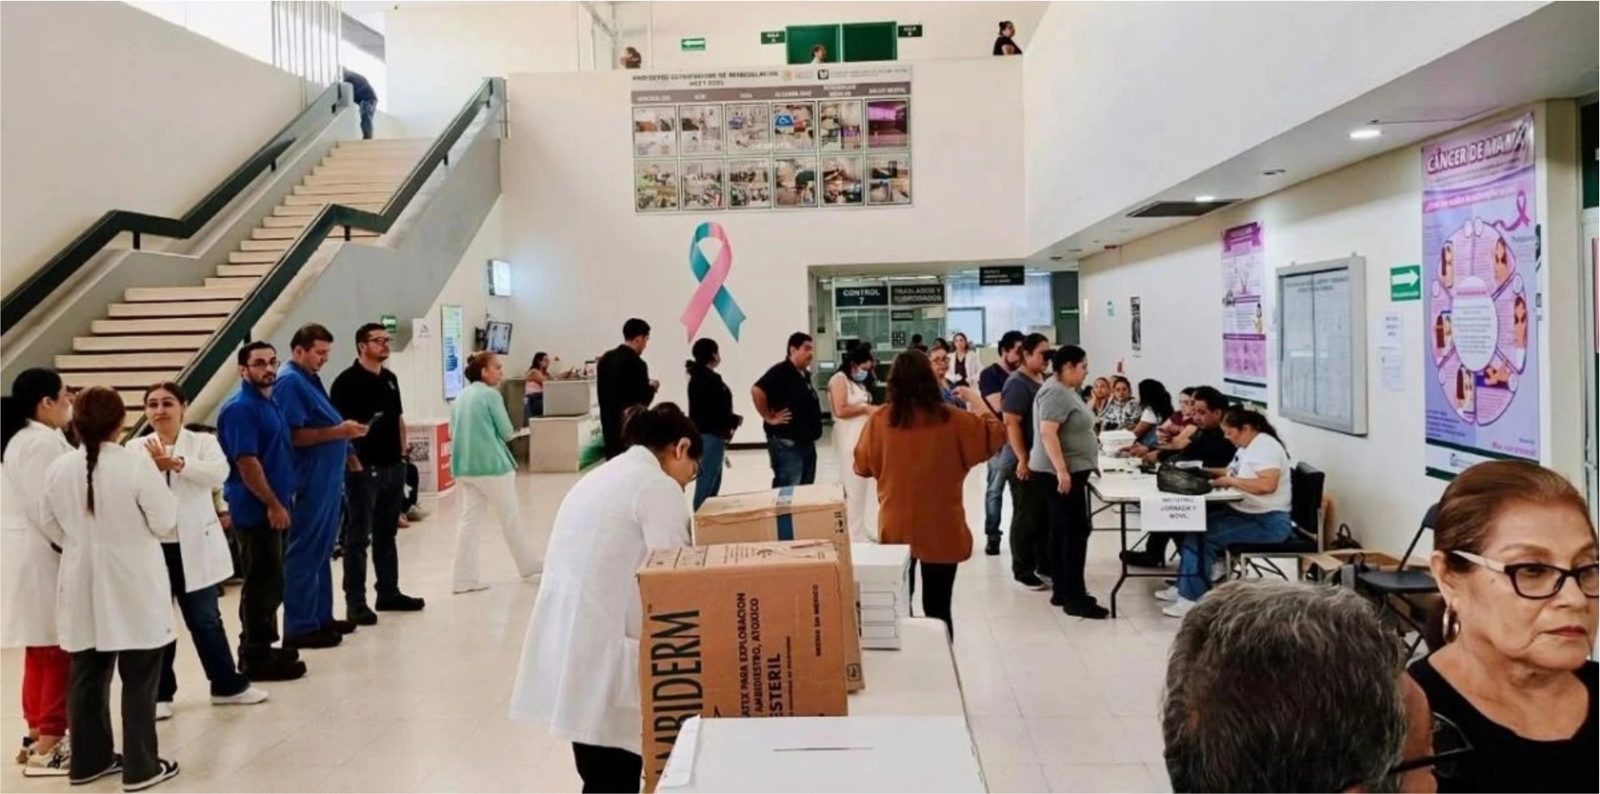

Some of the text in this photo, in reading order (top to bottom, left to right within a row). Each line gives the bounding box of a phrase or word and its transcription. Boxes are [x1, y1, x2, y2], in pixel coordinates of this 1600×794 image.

[1427, 146, 1467, 174] CÁNCER
[1469, 141, 1485, 163] DE
[842, 288, 881, 297] CONTROL
[894, 286, 942, 295] TRASLADOS Y
[858, 297, 865, 305] 7
[894, 294, 942, 302] SUBROGADOS
[750, 598, 760, 642] ATOXICO
[814, 617, 820, 628] EN
[737, 593, 750, 717] ATEX PARA EXPLORACION
[649, 610, 704, 776] BIDERM
